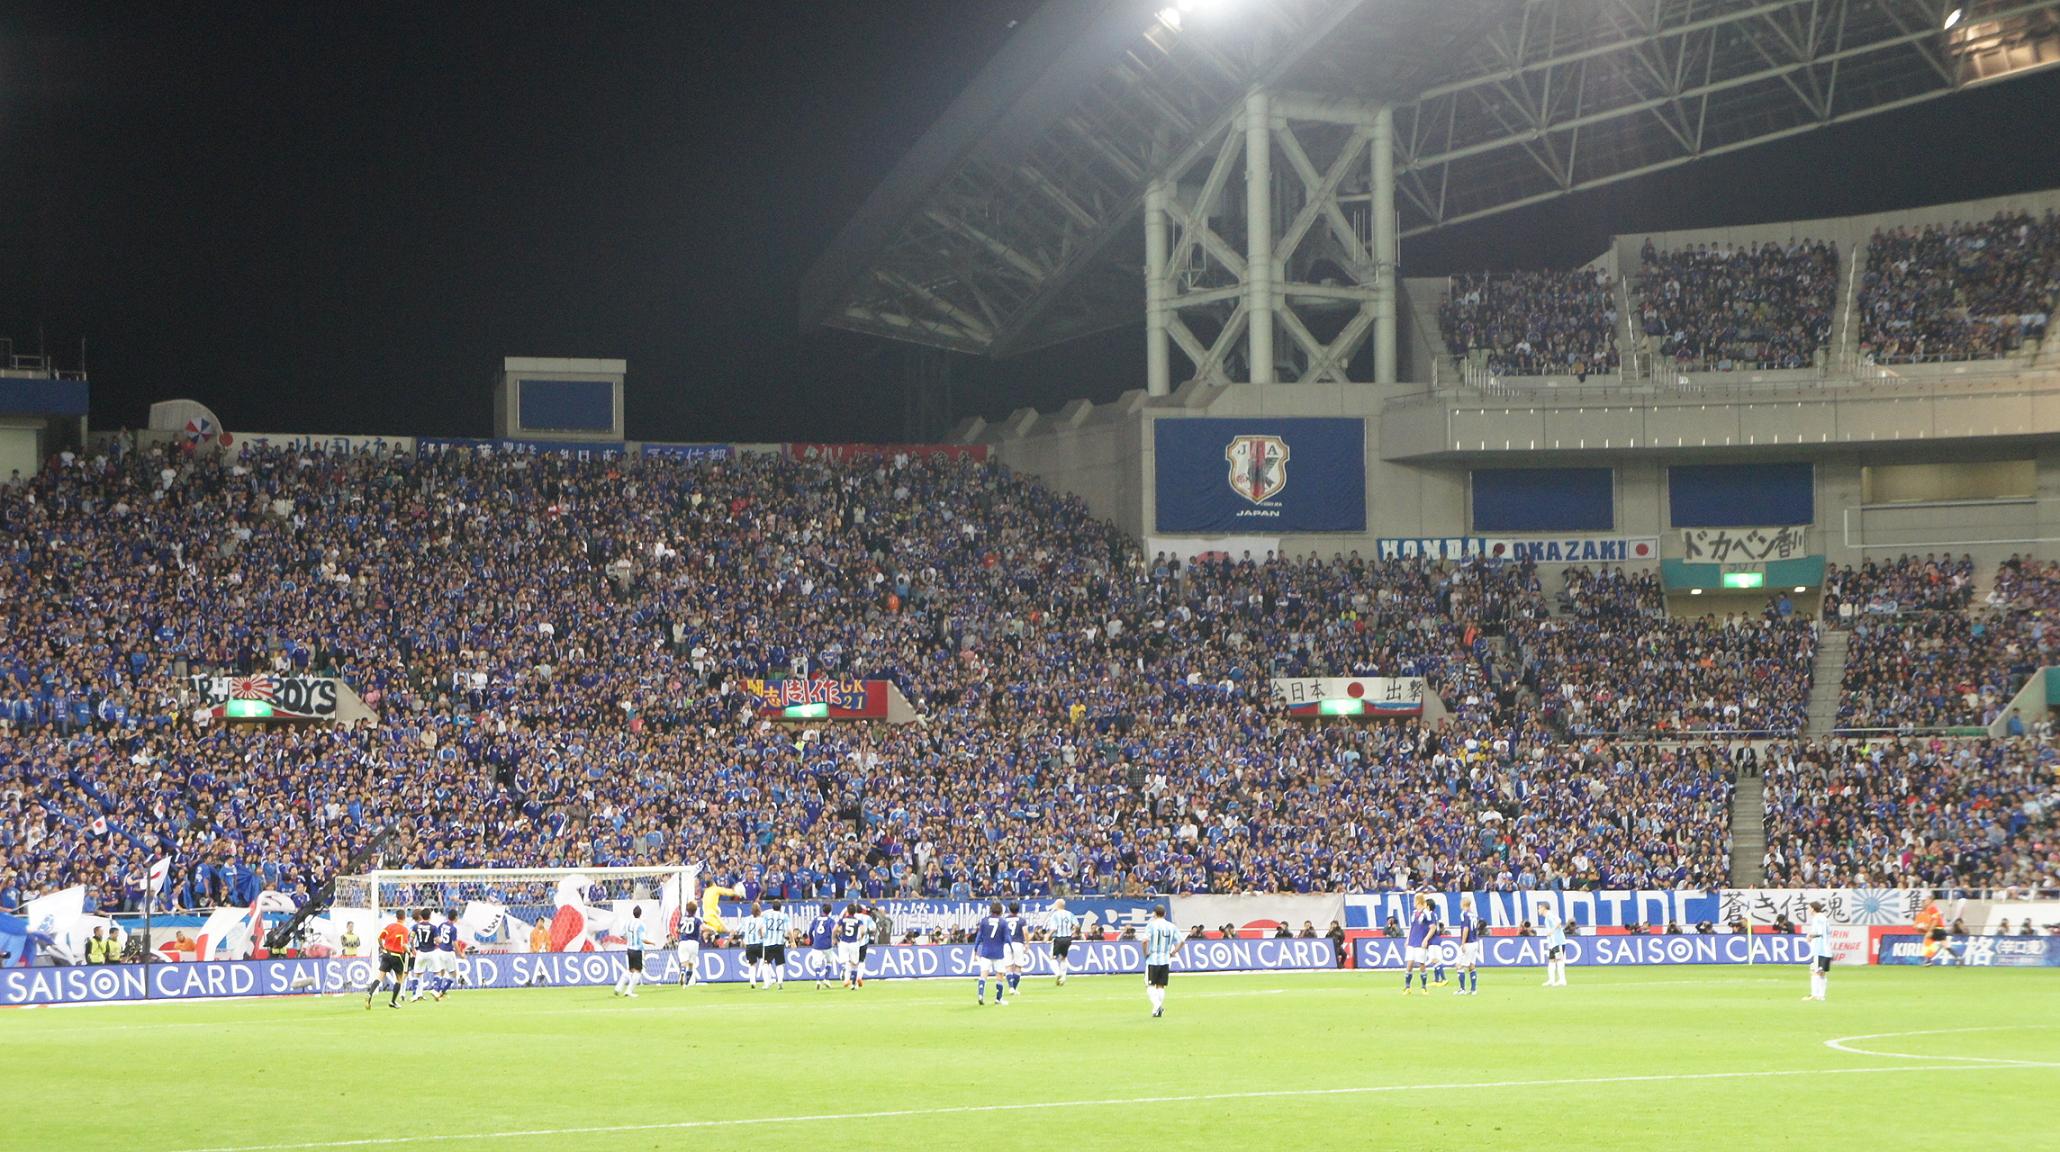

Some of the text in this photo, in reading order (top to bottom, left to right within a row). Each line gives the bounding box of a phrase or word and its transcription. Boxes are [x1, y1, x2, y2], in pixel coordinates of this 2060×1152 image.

[1381, 539, 1480, 561] HONDA
[1512, 539, 1627, 561] OKAZAKI
[1271, 679, 1326, 701] 全日本
[842, 695, 864, 709] 21
[680, 920, 694, 934] 20
[766, 918, 784, 931] 22
[816, 921, 825, 934] 6
[844, 922, 855, 937] 5
[988, 920, 999, 938] 7
[1008, 922, 1017, 935] 9
[417, 928, 431, 943] 17
[1156, 928, 1171, 945] 14
[1831, 929, 1849, 939] RIN
[1595, 937, 1717, 964] SAISON
[1725, 936, 1812, 963] CARD
[1892, 941, 1924, 957] KIRI
[7, 967, 146, 1003] SAISON
[156, 963, 254, 996] CARD
[270, 960, 388, 993] SAISO
[512, 953, 630, 985] SAISON
[864, 948, 938, 976] CARD
[950, 945, 1054, 975] SAON
[1066, 944, 1139, 972] CARD
[1168, 941, 1255, 970] AISON
[1257, 941, 1331, 967] CARD
